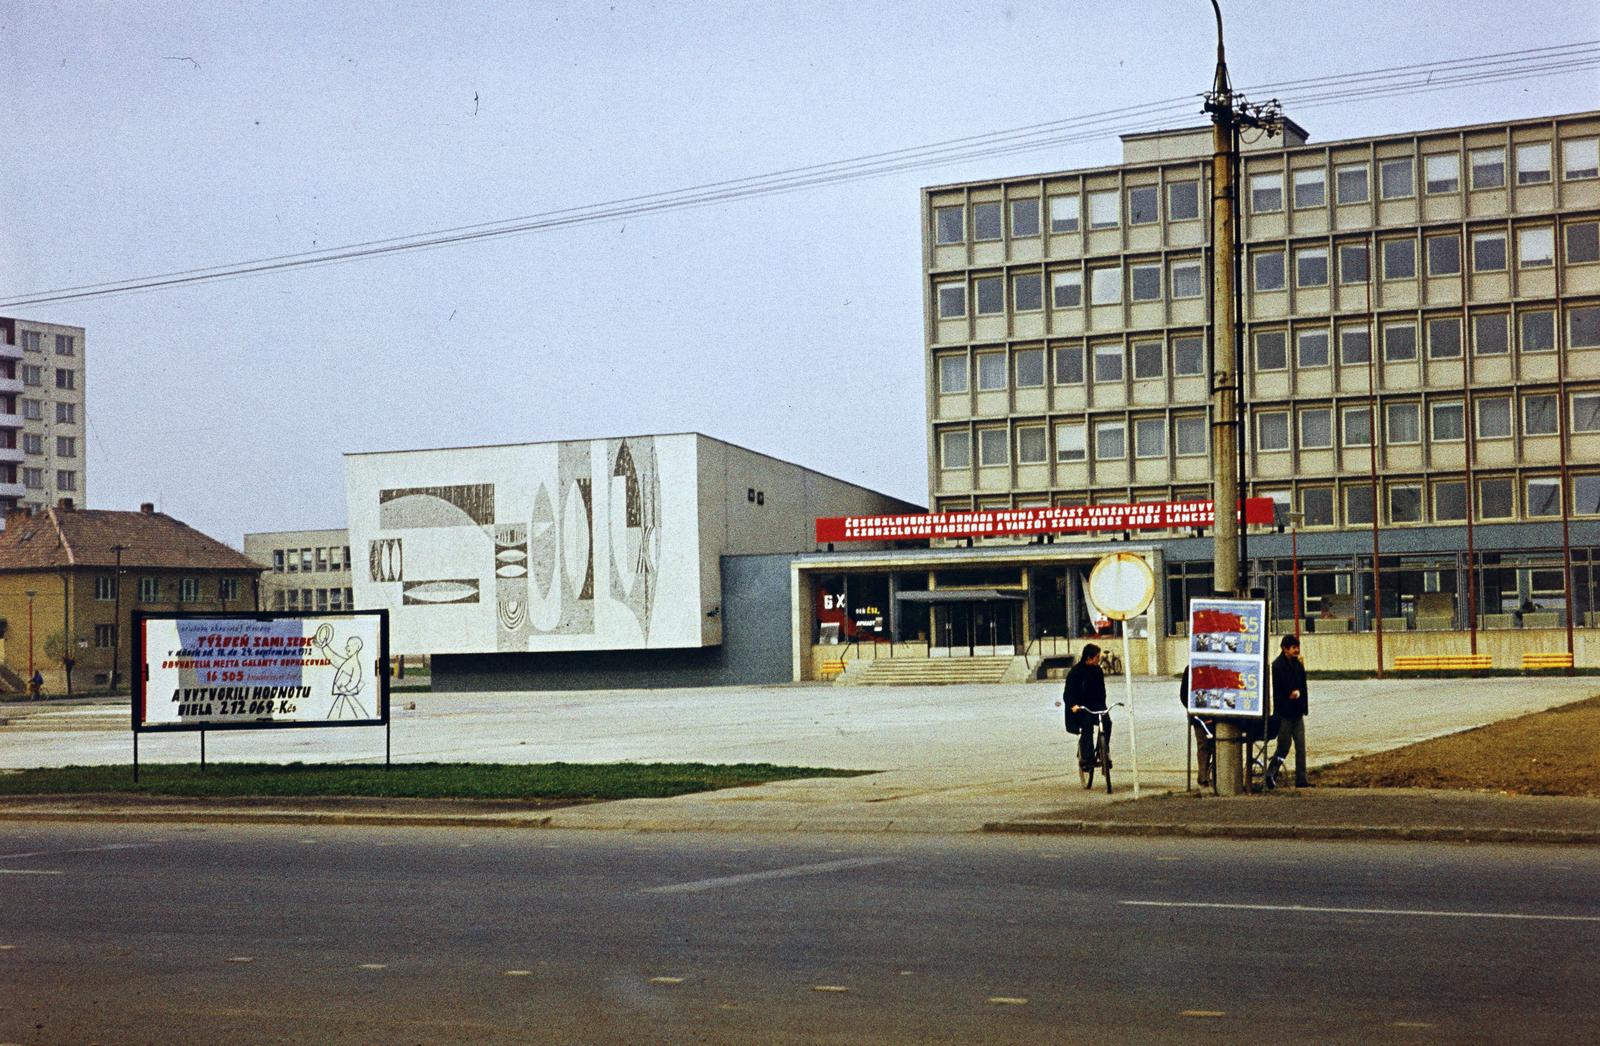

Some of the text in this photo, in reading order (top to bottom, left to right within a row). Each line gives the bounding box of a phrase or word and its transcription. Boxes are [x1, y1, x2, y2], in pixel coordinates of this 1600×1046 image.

[844, 514, 946, 528] ČESKOSLOVENSKÁ
[949, 513, 993, 523] ARMÁDA
[1038, 508, 1083, 519] SÚČASŤ
[1088, 504, 1161, 517] VARŠAVSKEJ
[1165, 502, 1213, 513] ZMLUVY
[934, 522, 993, 533] HADSEREG
[996, 522, 1004, 531] A
[1005, 519, 1046, 530] VARSÓI
[823, 594, 833, 610] 6
[1239, 616, 1259, 632] 55
[253, 636, 284, 647] SAMI
[213, 659, 239, 668] MESTA
[222, 671, 244, 681] 505
[1238, 672, 1258, 689] 55
[171, 686, 312, 702] A VYTVORILI HODNOTU
